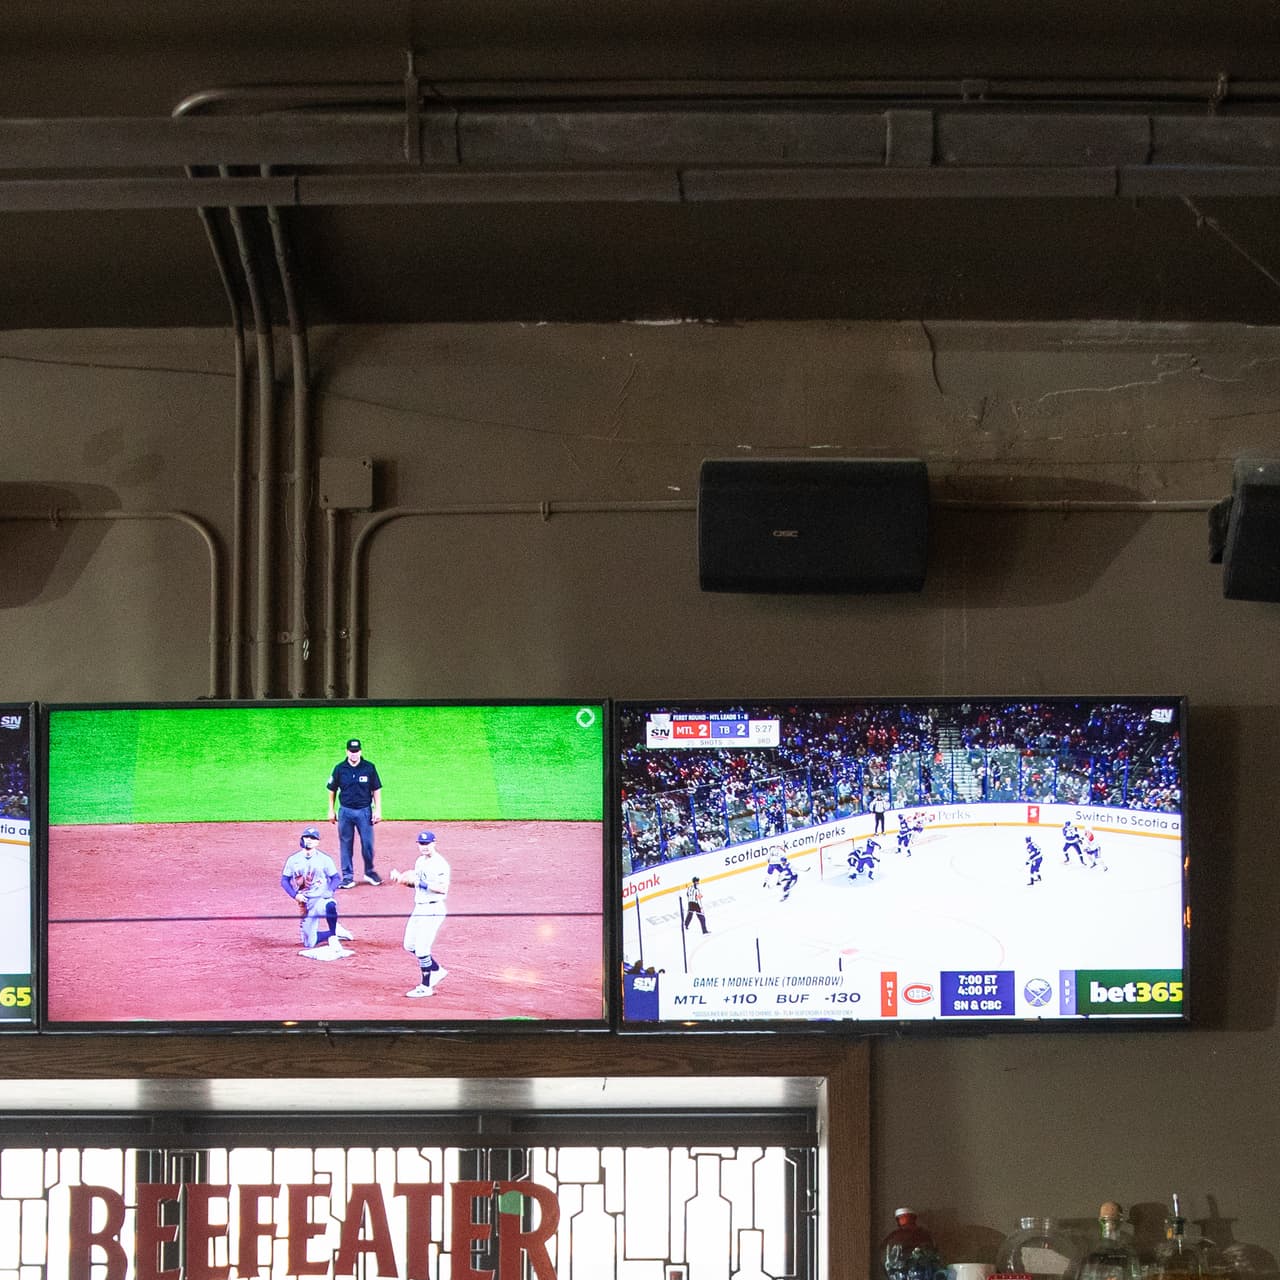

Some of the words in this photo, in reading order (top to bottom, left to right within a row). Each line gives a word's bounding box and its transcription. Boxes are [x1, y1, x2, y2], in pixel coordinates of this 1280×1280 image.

[0, 715, 22, 729] SN
[651, 728, 670, 738] SN
[676, 726, 694, 735] MTL
[698, 724, 708, 737] 2
[719, 726, 730, 735] TB
[736, 723, 746, 736] 2
[755, 725, 773, 733] 5:27
[1076, 811, 1113, 823] Switch
[1116, 814, 1128, 824] to
[1131, 816, 1168, 829] Scotia
[693, 977, 719, 988] GAME
[727, 976, 780, 988] MONEYLINE
[781, 975, 844, 989] (TOMORROW)
[958, 975, 983, 985] 7:00
[984, 974, 997, 984] ET
[886, 981, 894, 1008] MTL
[958, 985, 983, 996] 4:00
[984, 985, 998, 995] PT
[1090, 981, 1184, 1004] bet365
[674, 995, 708, 1005] MTL
[723, 994, 758, 1004] +110
[776, 994, 810, 1004] BUF
[824, 992, 861, 1003] -130
[954, 1000, 968, 1011] SN
[970, 1001, 979, 1010] &
[980, 1000, 1002, 1010] CBC
